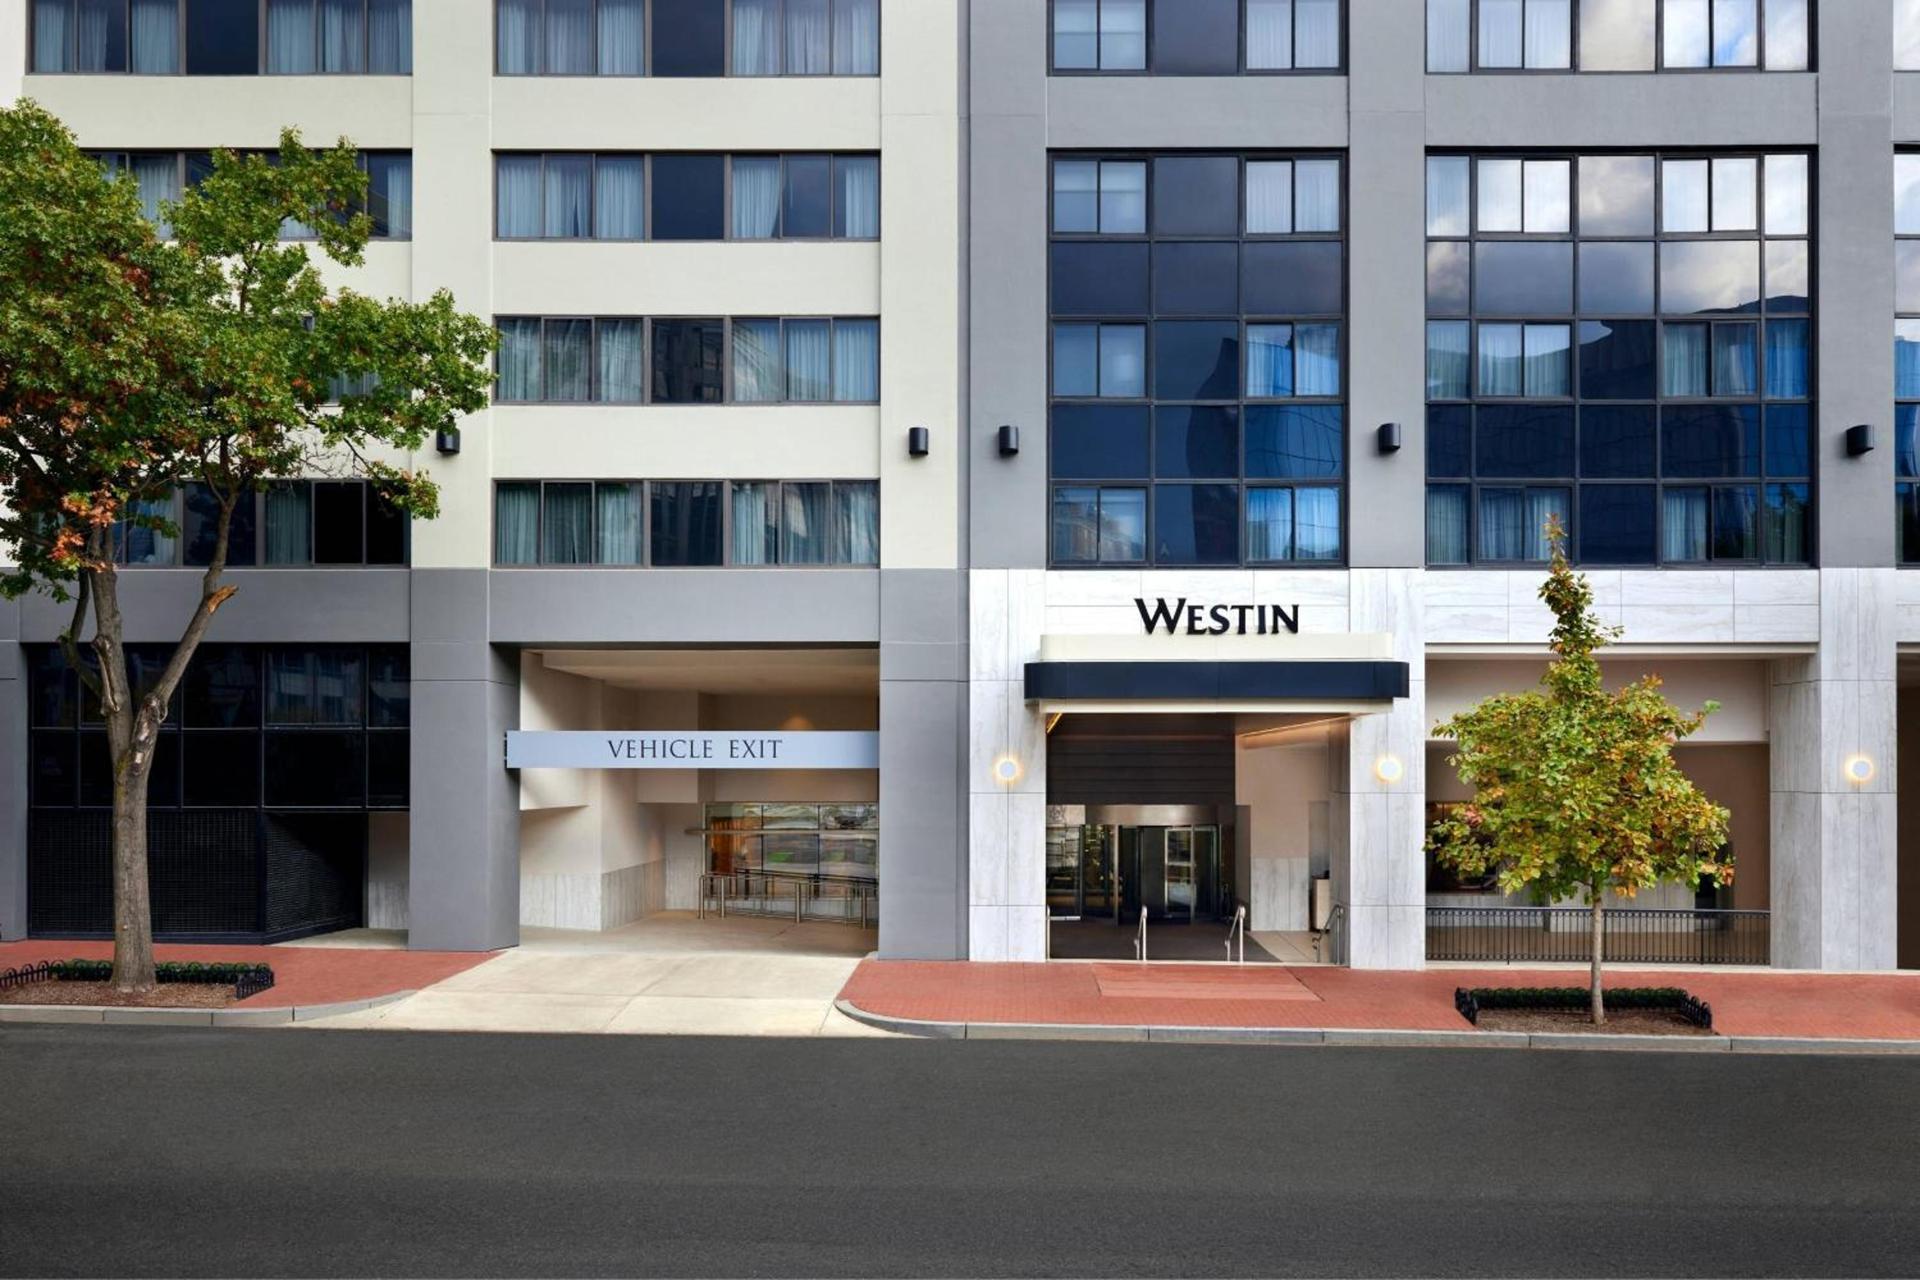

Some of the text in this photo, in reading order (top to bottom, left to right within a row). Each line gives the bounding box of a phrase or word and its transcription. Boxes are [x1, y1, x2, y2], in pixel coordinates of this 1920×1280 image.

[1135, 597, 1300, 635] WESTIN
[607, 738, 783, 759] VEHICLE EXIT
